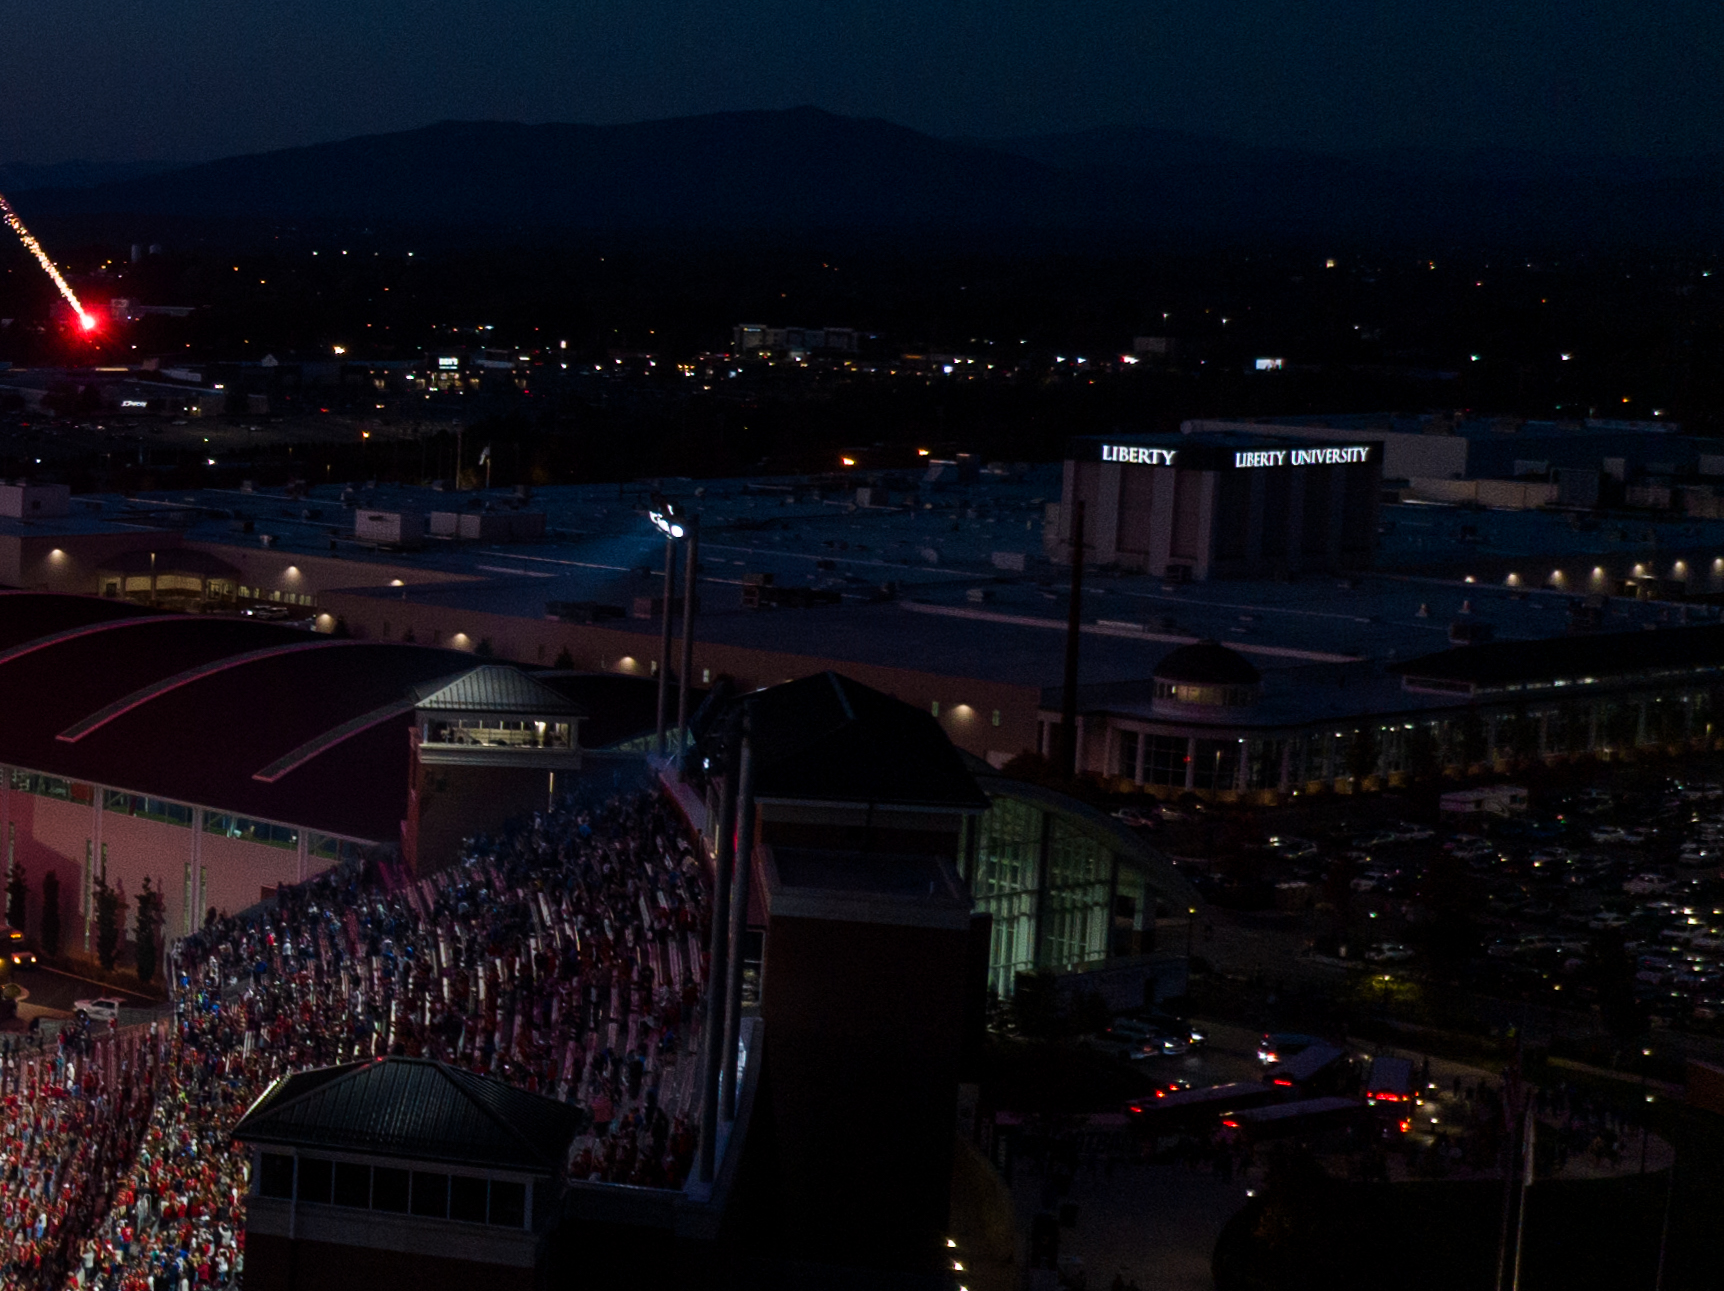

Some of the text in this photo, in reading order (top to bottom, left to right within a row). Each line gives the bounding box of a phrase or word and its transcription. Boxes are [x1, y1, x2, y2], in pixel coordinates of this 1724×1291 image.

[1103, 445, 1177, 466] LIBERTY
[1236, 447, 1370, 468] LIBERTY UNIVERSITY
